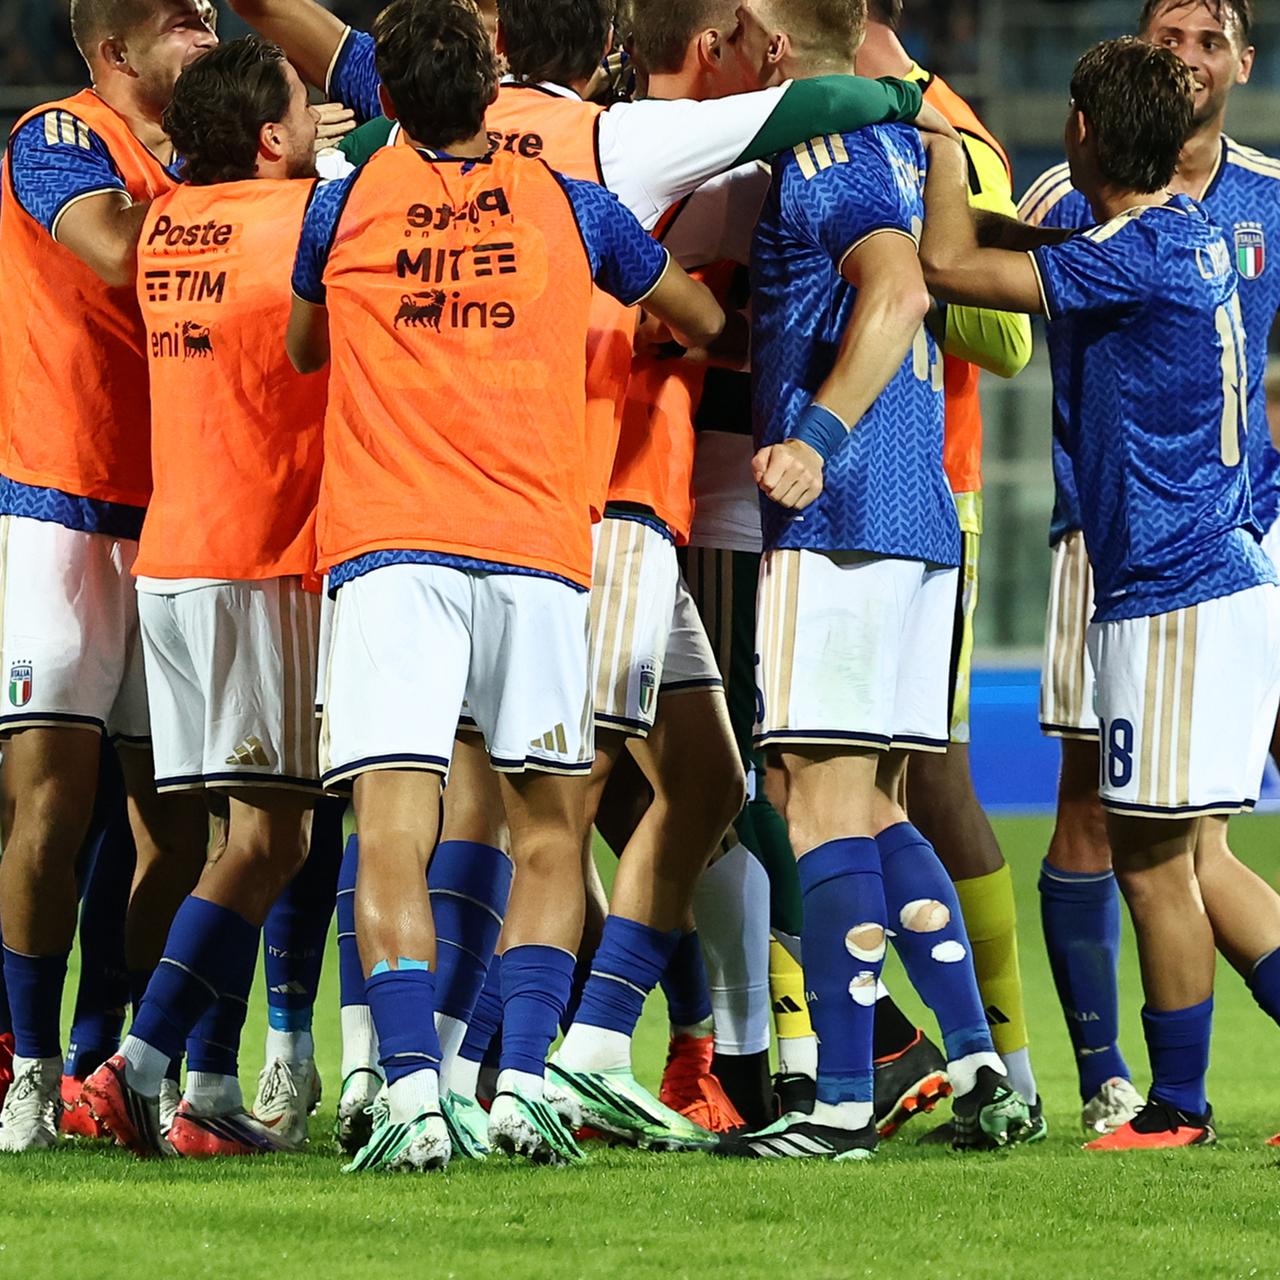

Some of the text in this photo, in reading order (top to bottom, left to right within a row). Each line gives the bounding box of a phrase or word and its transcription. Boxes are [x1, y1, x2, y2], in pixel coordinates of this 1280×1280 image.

[487, 131, 543, 158] ste
[147, 215, 232, 246] Poste
[175, 270, 227, 303] TIM
[151, 322, 179, 358] eni
